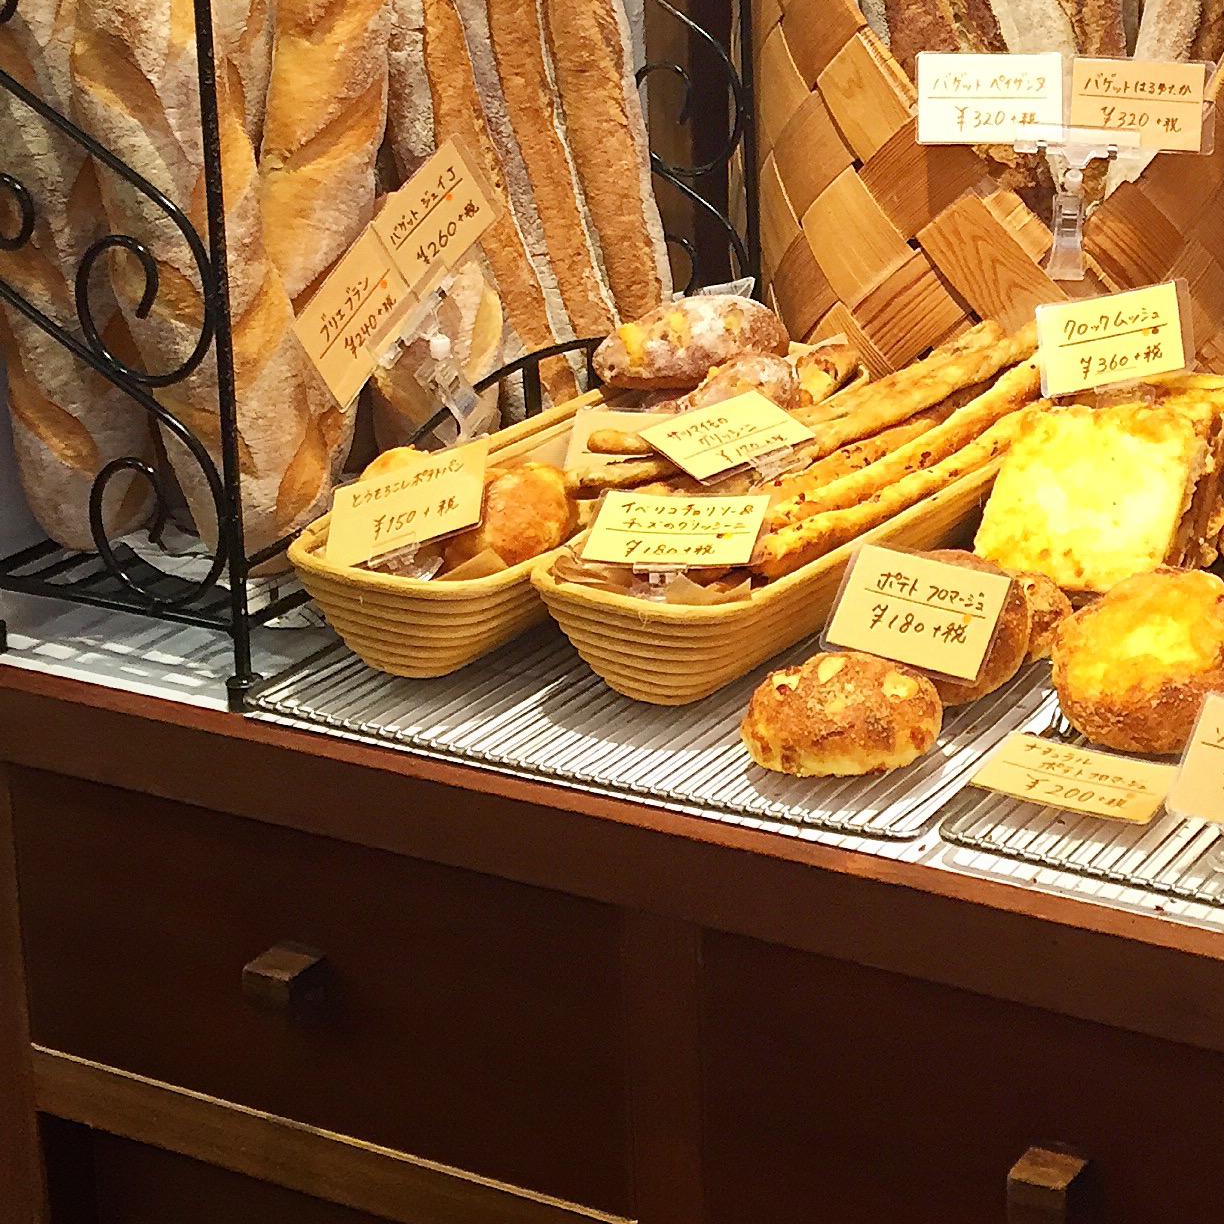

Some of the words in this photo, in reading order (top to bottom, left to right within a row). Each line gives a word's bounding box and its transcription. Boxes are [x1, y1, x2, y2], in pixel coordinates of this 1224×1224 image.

[955, 106, 1038, 132] ¥320+税
[1101, 106, 1182, 133] ¥320+税
[416, 199, 480, 265] ¥260+税
[344, 294, 397, 359] ¥240+税
[1080, 342, 1163, 380] ¥360+税
[373, 496, 459, 541] ¥150+税
[869, 604, 967, 644] ¥180+税
